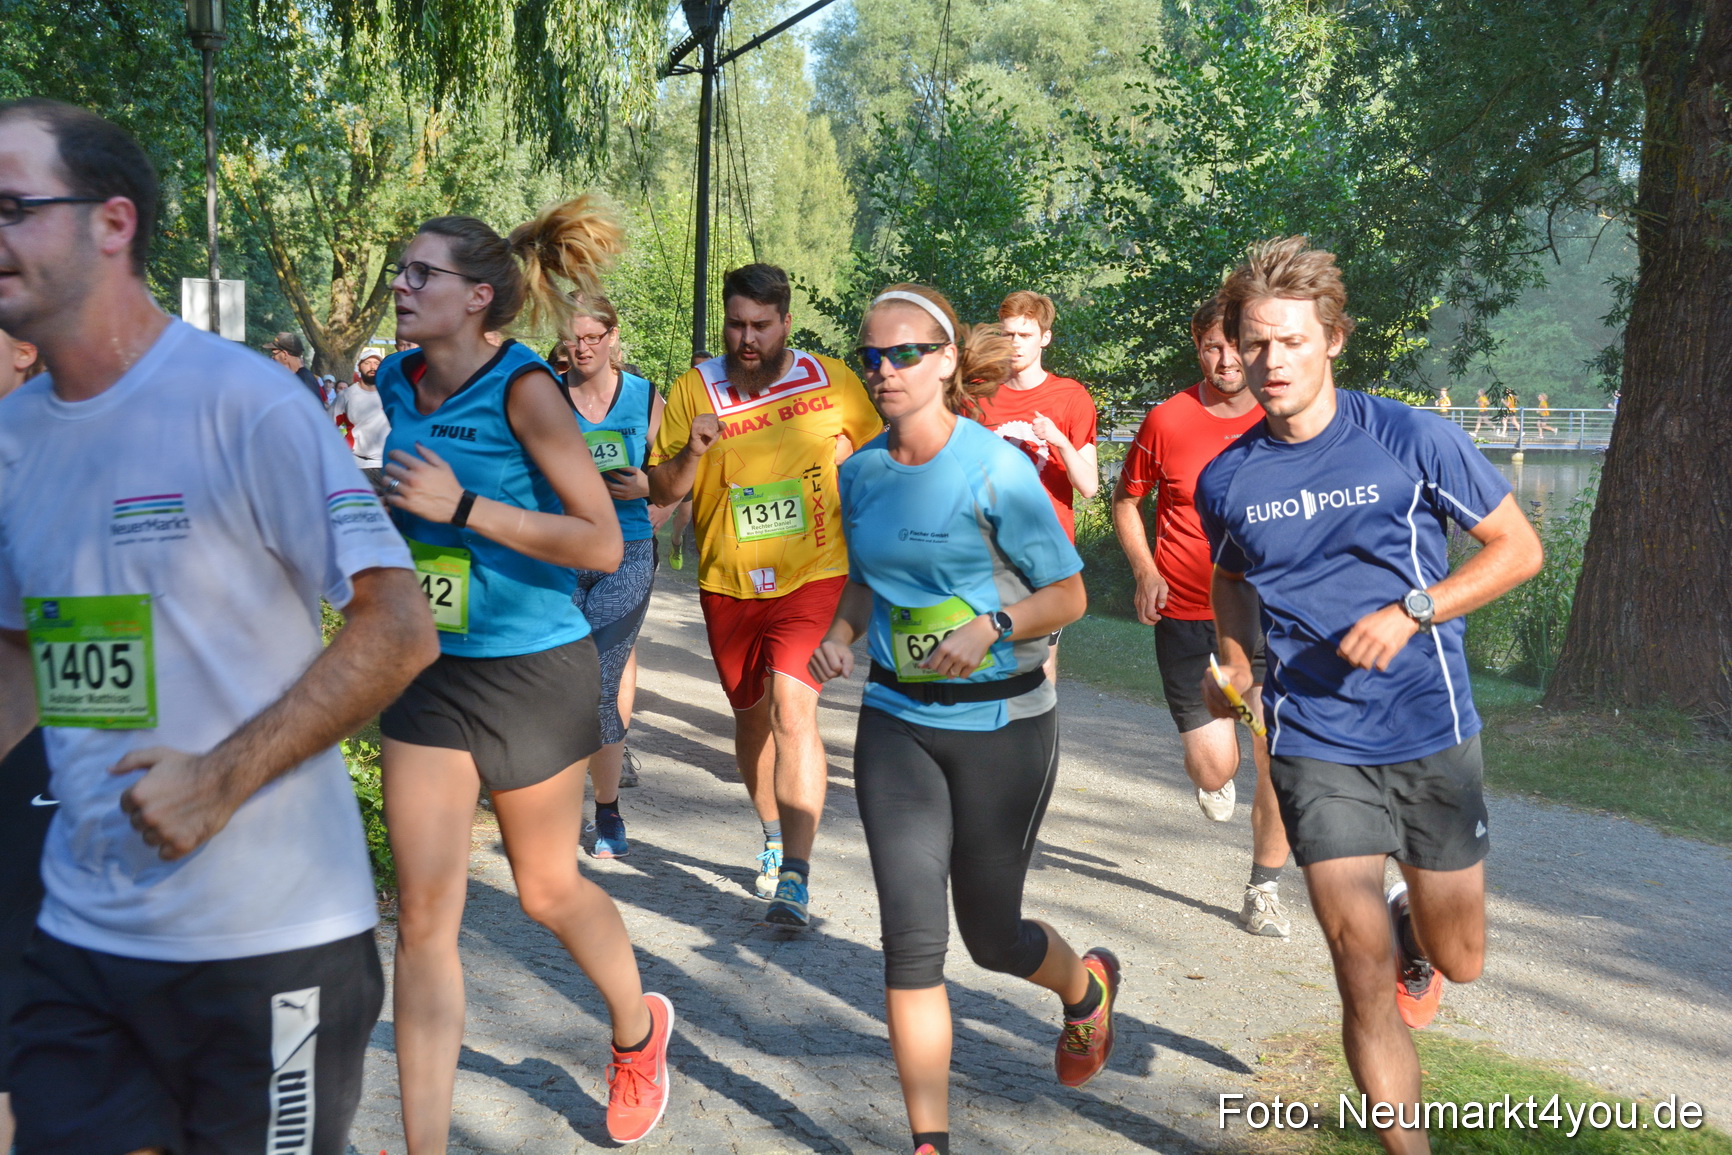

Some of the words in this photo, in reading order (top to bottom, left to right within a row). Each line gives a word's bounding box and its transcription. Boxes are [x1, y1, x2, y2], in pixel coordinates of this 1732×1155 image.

[430, 424, 477, 442] THULE
[720, 413, 773, 440] MAX
[778, 396, 833, 421] BÖGL
[589, 443, 618, 459] 43
[742, 499, 797, 525] 1312
[1246, 498, 1299, 524] EURO
[1319, 484, 1380, 510] POLES
[906, 629, 955, 661] 62
[41, 643, 134, 690] 1405
